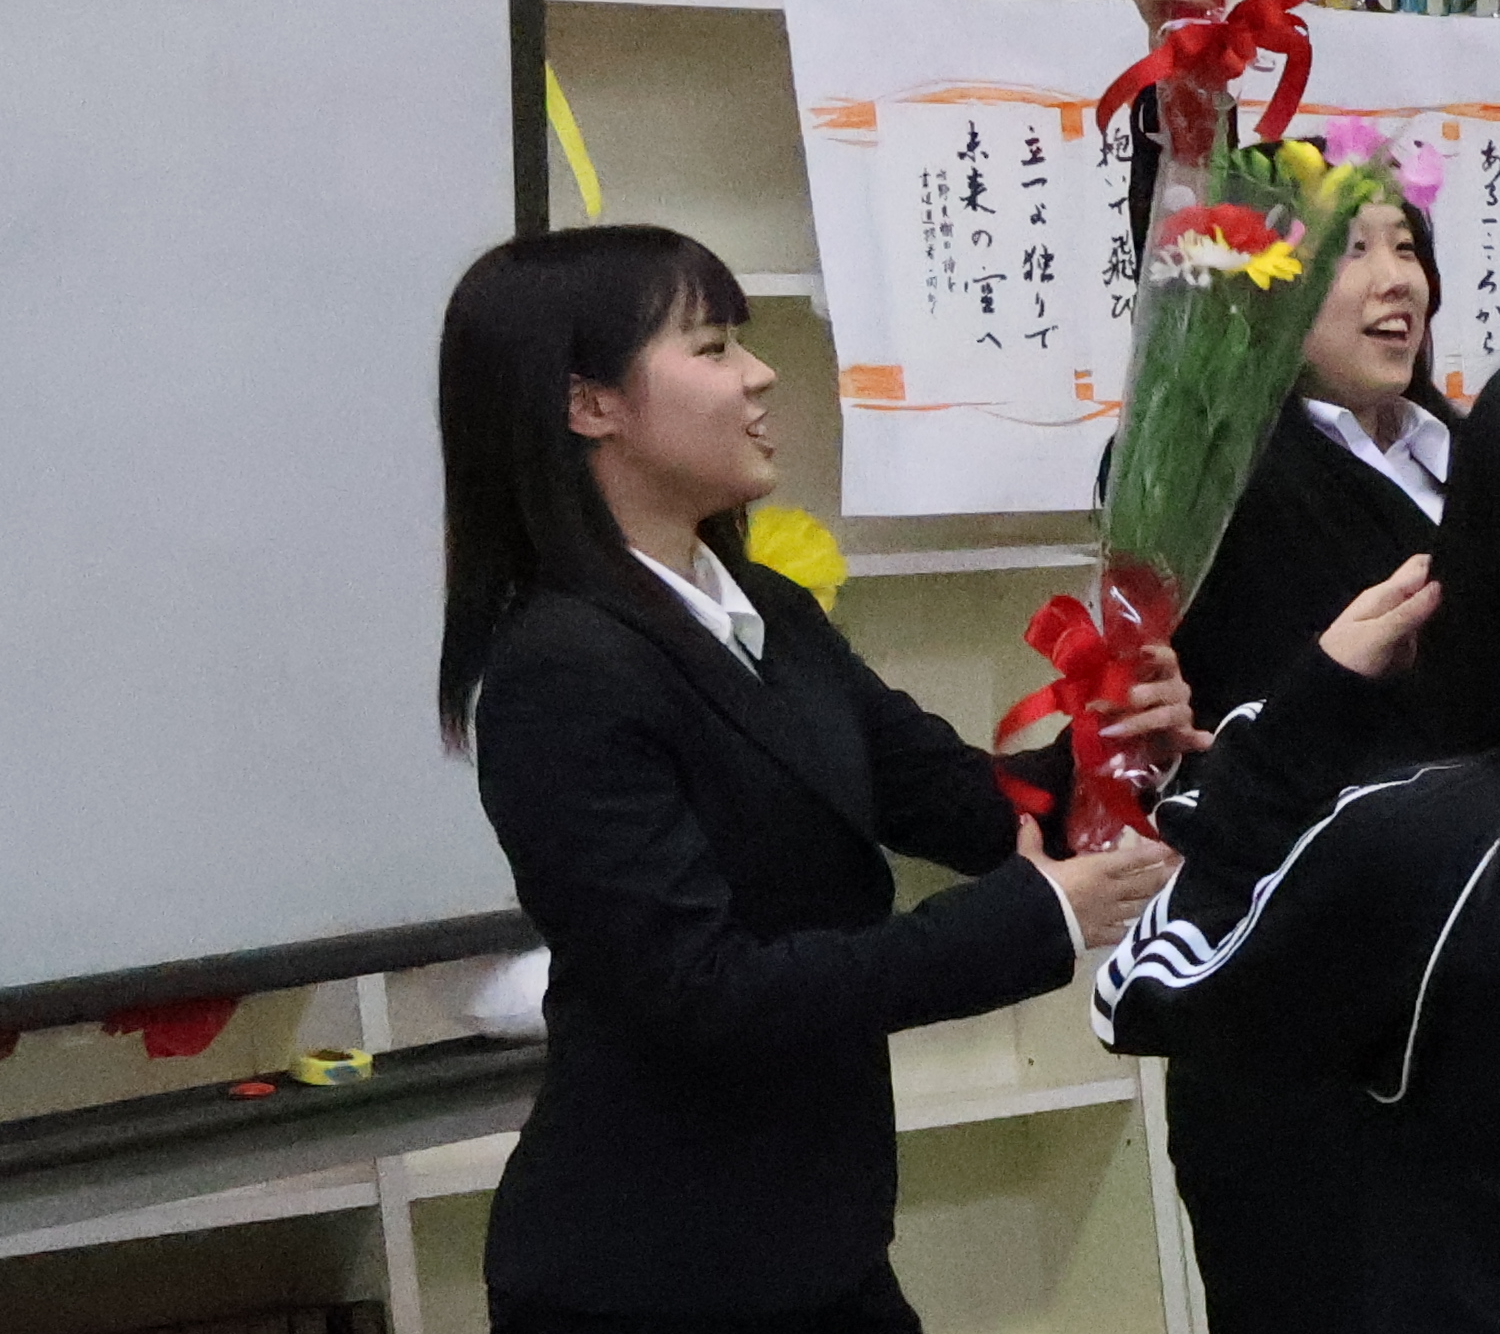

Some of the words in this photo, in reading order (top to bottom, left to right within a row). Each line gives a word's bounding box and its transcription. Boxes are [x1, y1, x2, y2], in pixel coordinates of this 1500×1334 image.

[957, 120, 1008, 350] 未来の空へ
[1021, 125, 1059, 349] 立つよ独りで
